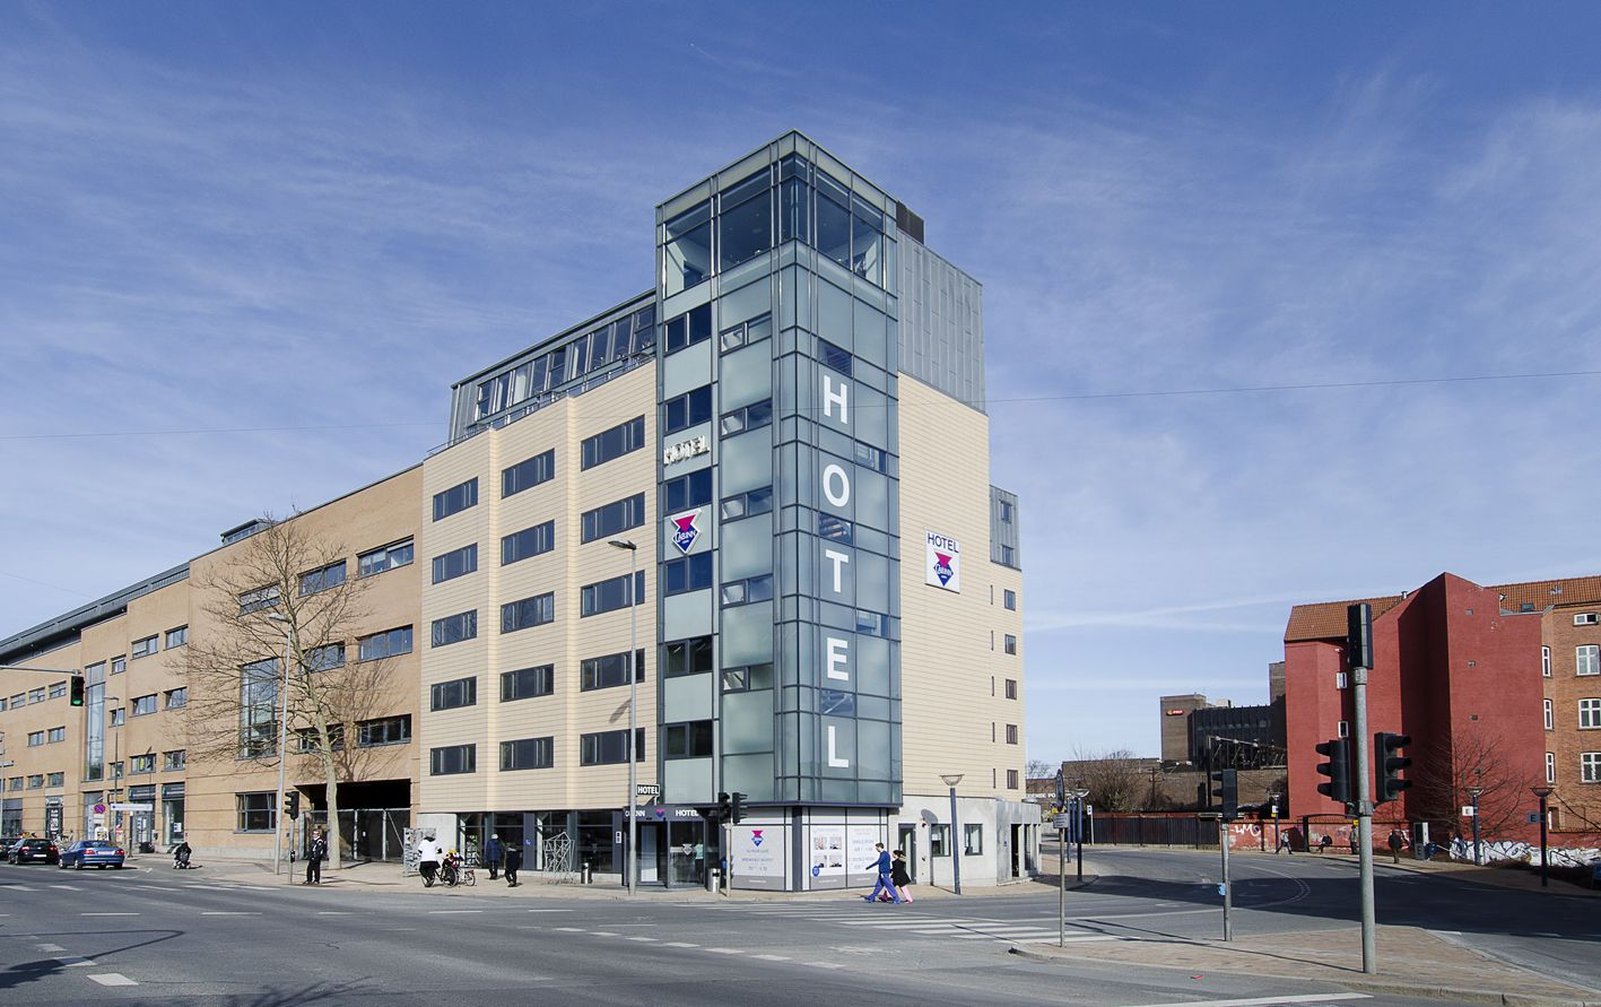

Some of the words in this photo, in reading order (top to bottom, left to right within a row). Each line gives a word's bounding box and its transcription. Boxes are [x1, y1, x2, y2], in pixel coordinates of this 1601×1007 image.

[664, 435, 710, 465] HOTEL
[927, 532, 959, 553] HOTEL
[823, 375, 850, 769] HOTEL
[637, 786, 659, 795] HOTEL
[675, 809, 699, 817] HOTEL
[1530, 814, 1537, 823] E
